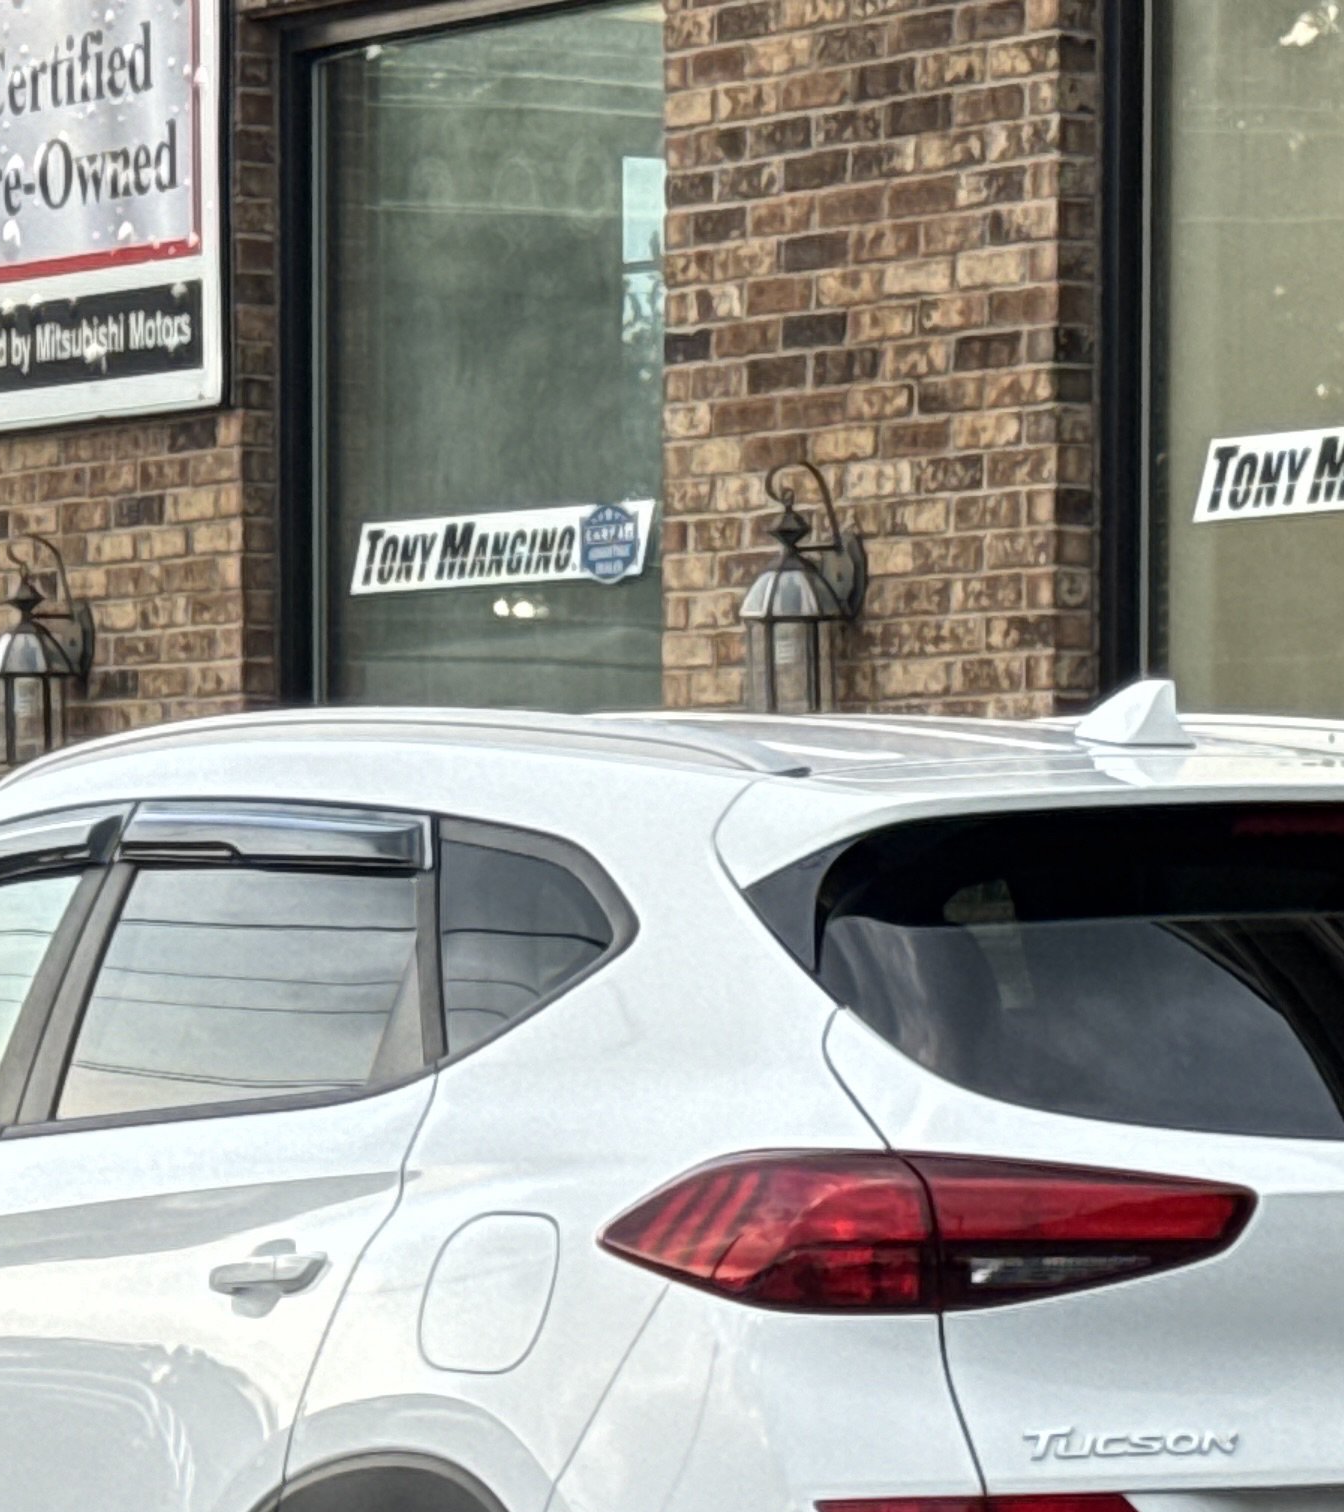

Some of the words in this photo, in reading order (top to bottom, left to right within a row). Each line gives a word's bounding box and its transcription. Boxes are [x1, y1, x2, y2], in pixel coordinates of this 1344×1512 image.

[11, 327, 32, 376] by
[35, 313, 125, 364] Mitsubishi
[129, 309, 192, 350] Motors
[1207, 444, 1312, 513] TONY
[361, 528, 438, 587] TONY
[1022, 1426, 1240, 1462] TUCSON
